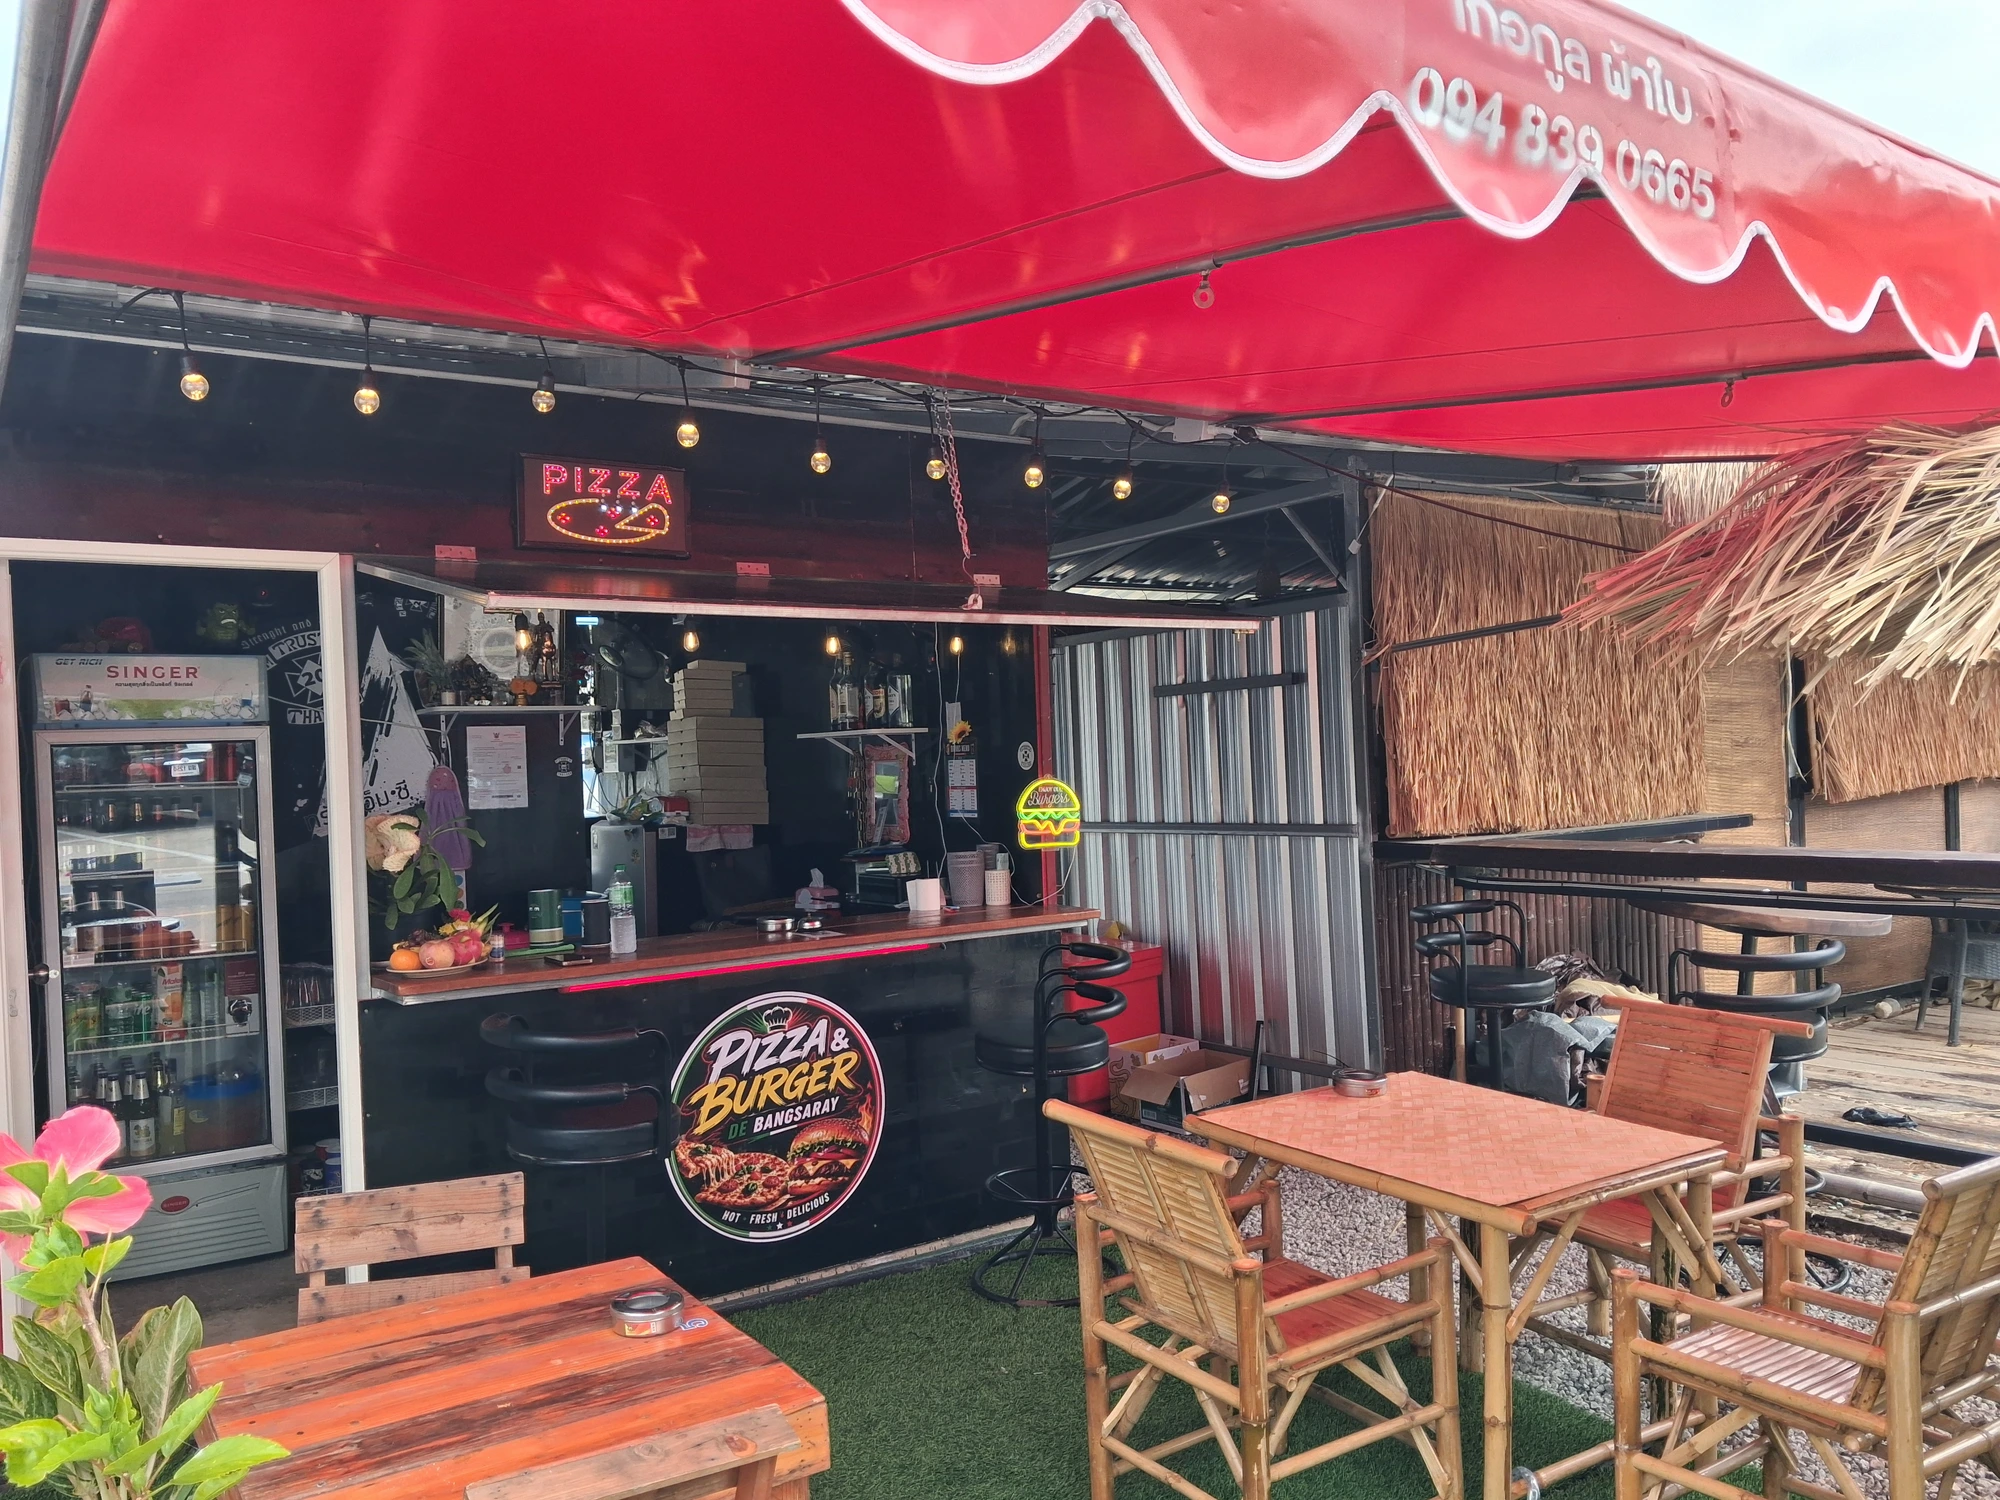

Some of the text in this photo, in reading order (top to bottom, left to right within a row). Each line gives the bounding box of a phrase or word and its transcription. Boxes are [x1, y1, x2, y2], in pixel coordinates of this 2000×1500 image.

[1601, 39, 1693, 125] ผ้าใบ
[1409, 67, 1716, 218] 094 839 0665
[543, 463, 673, 505] PIZZA
[55, 658, 77, 666] GET
[107, 665, 199, 679] SINGER
[1028, 790, 1070, 808] Burgers
[708, 1018, 850, 1081] PIZZA &
[689, 1051, 859, 1136] BURGER
[728, 1096, 840, 1141] DE BANGSARAY
[722, 1192, 830, 1225] HOT FRESH DELICIOUS
